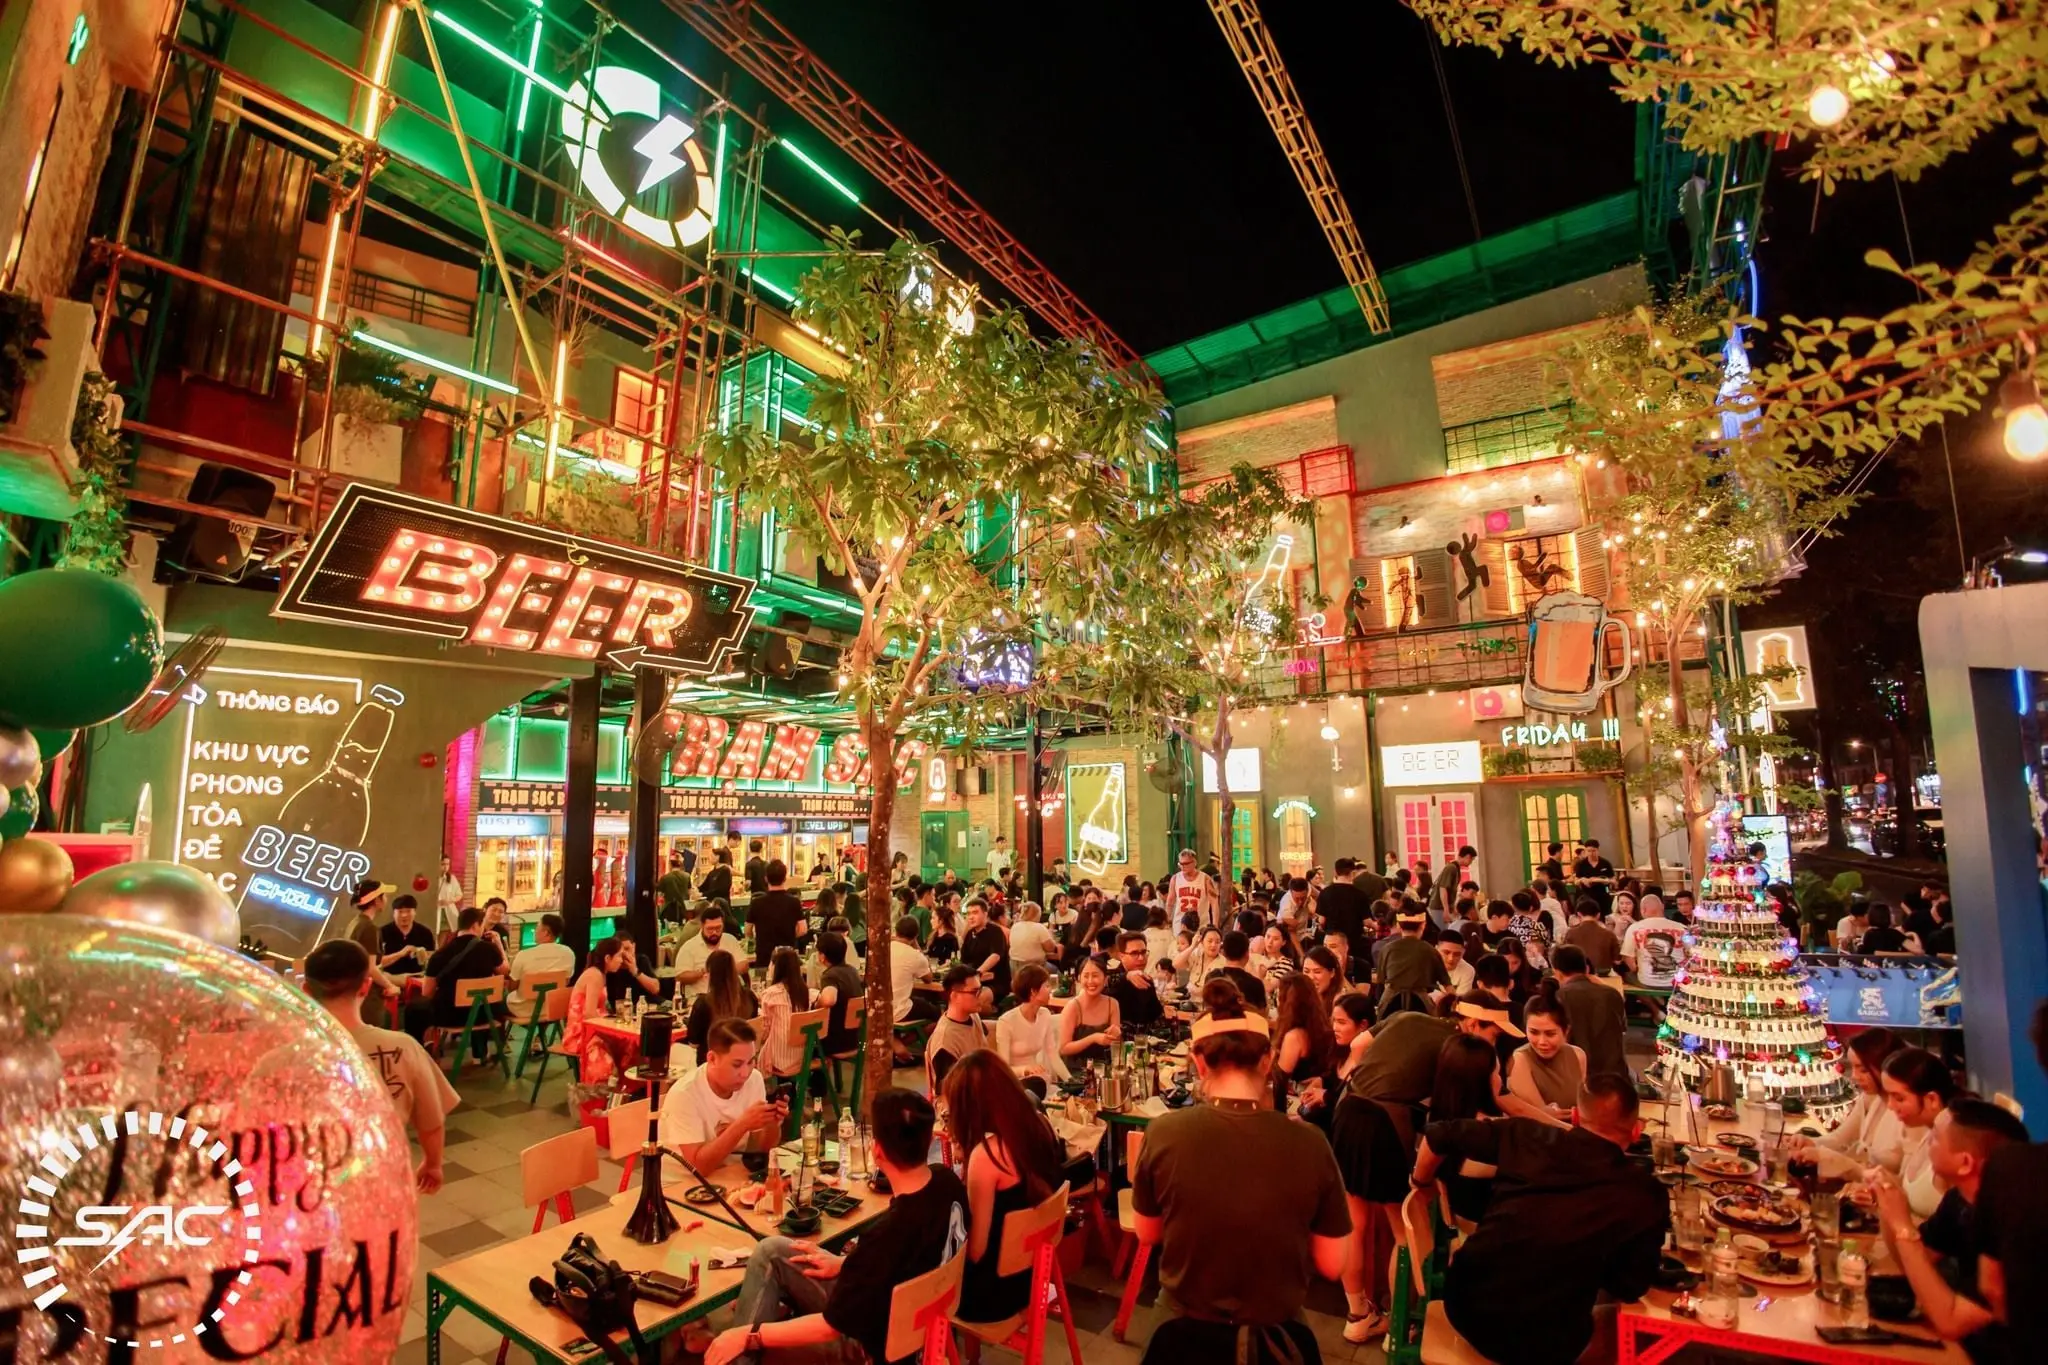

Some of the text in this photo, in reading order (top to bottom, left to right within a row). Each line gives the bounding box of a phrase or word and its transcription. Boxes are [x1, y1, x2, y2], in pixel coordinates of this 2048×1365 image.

[360, 528, 693, 659] BEER
[216, 688, 340, 715] THÔNG BÁO
[1501, 718, 1620, 747] FRIDAY !!!
[192, 740, 311, 768] KHU VỰC
[189, 773, 284, 795] PHONG
[493, 789, 529, 806] TRẠM
[531, 791, 555, 807] SẠC
[669, 795, 697, 809] TRẠM
[698, 796, 716, 810] SẠC
[188, 800, 243, 826] TỎA
[242, 825, 371, 894] BEER
